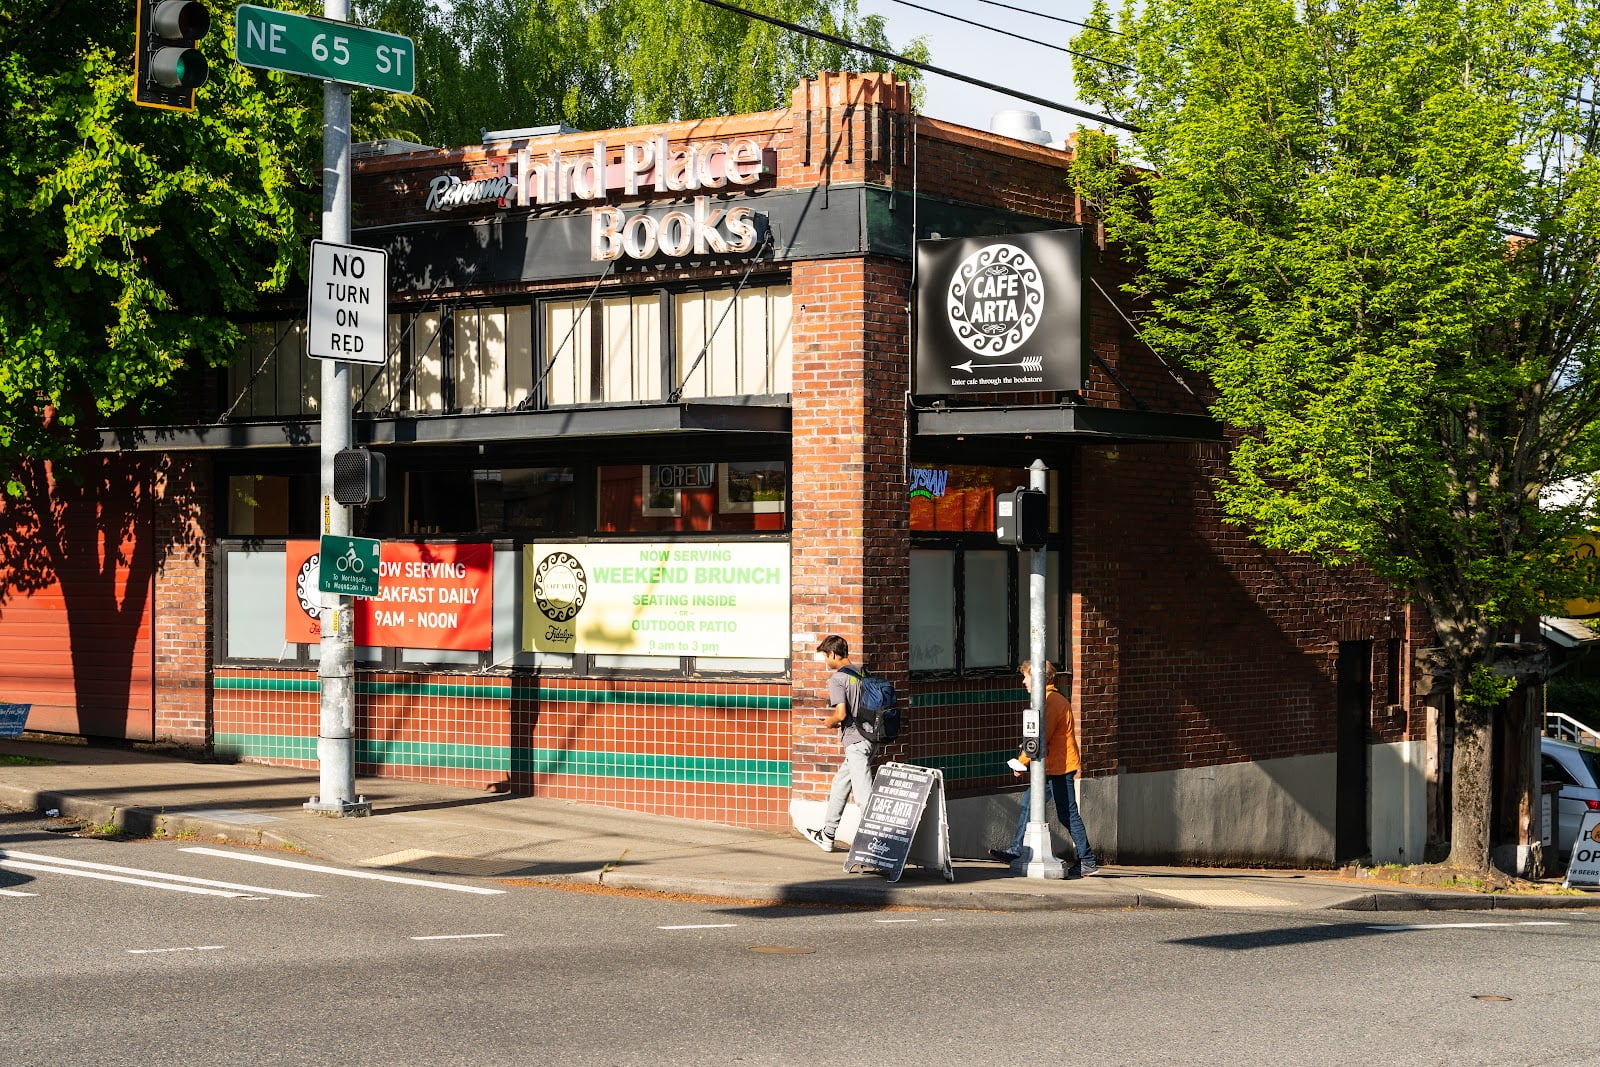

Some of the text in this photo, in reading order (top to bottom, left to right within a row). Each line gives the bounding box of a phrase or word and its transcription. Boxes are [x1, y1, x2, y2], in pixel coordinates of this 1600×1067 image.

[247, 20, 406, 76] NE 65 ST
[487, 133, 763, 208] Third Place
[425, 175, 513, 211] Ravenna
[591, 195, 758, 262] Books
[332, 253, 365, 279] NO
[326, 282, 370, 305] TURN
[973, 274, 1019, 299] CAFE
[336, 308, 359, 328] ON
[970, 299, 1019, 324] ARTA
[331, 333, 364, 353] RED
[951, 378, 966, 386] Enter
[966, 377, 978, 385] cafe
[979, 377, 1001, 386] through
[660, 465, 709, 487] OPEN
[909, 468, 948, 497] LYSIAN
[639, 550, 732, 562] NOW SERVING
[333, 573, 367, 584] To Northgate
[379, 561, 466, 579] OW SERVING
[593, 566, 781, 585] WEEKEND BRUNCH
[325, 581, 331, 589] To
[361, 584, 373, 592] Park
[357, 585, 480, 605] EAKFAST DAILY
[632, 594, 737, 607] SEATING INSIDE
[374, 610, 405, 627] 9AM
[417, 612, 458, 629] NOON
[631, 619, 737, 633] OUTDOOR PATIO
[649, 640, 720, 653] 9 am to 3 pm
[872, 797, 913, 818] CAFE ARTA
